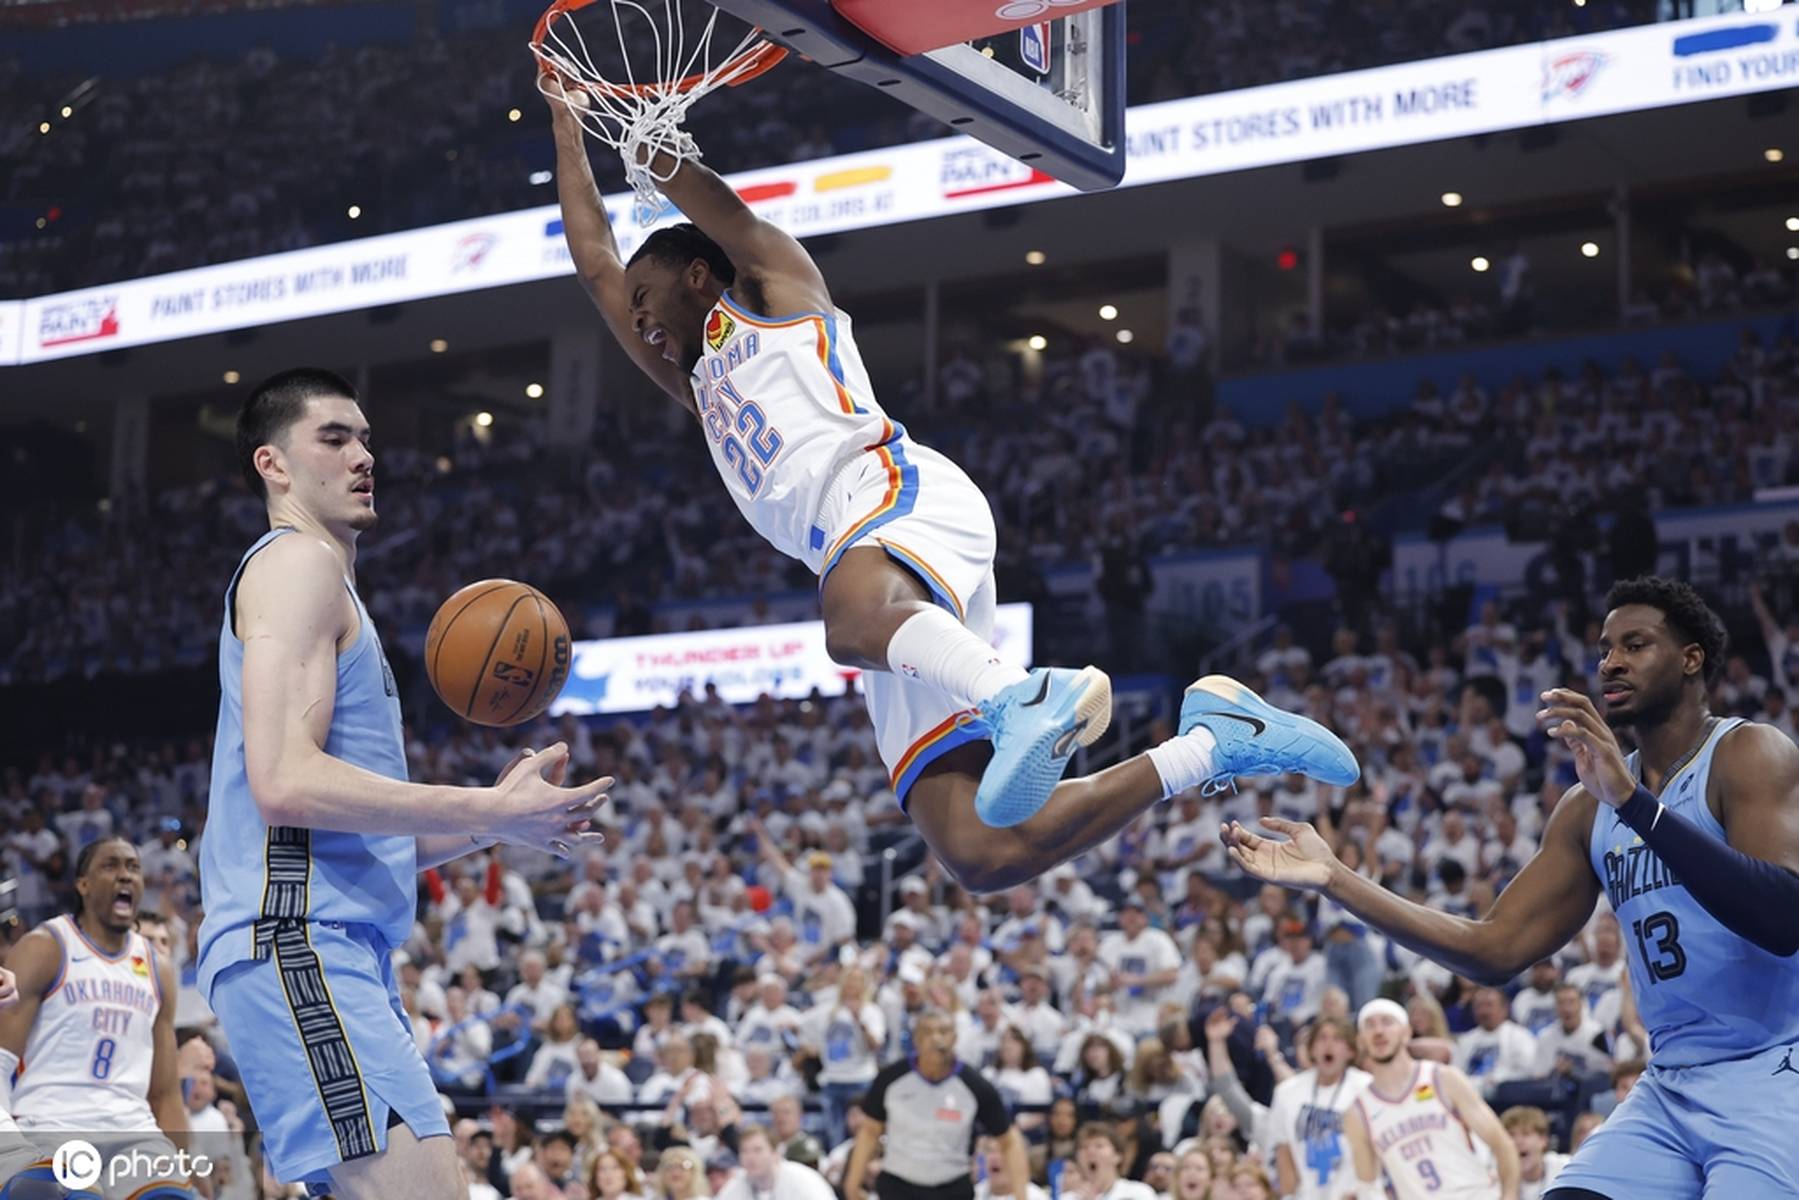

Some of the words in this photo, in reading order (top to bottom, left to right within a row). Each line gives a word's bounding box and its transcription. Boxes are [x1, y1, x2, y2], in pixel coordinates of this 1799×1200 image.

[1673, 60, 1732, 91] FIND
[1192, 107, 1302, 151] STORES
[1309, 96, 1385, 131] WITH
[1393, 78, 1478, 117] MORE
[720, 400, 785, 500] 22
[1631, 911, 1688, 986] 13
[62, 977, 156, 1018] OKLAHOMA
[91, 1006, 134, 1037] CITY
[91, 1037, 117, 1081] 8
[1415, 1157, 1443, 1193] 9
